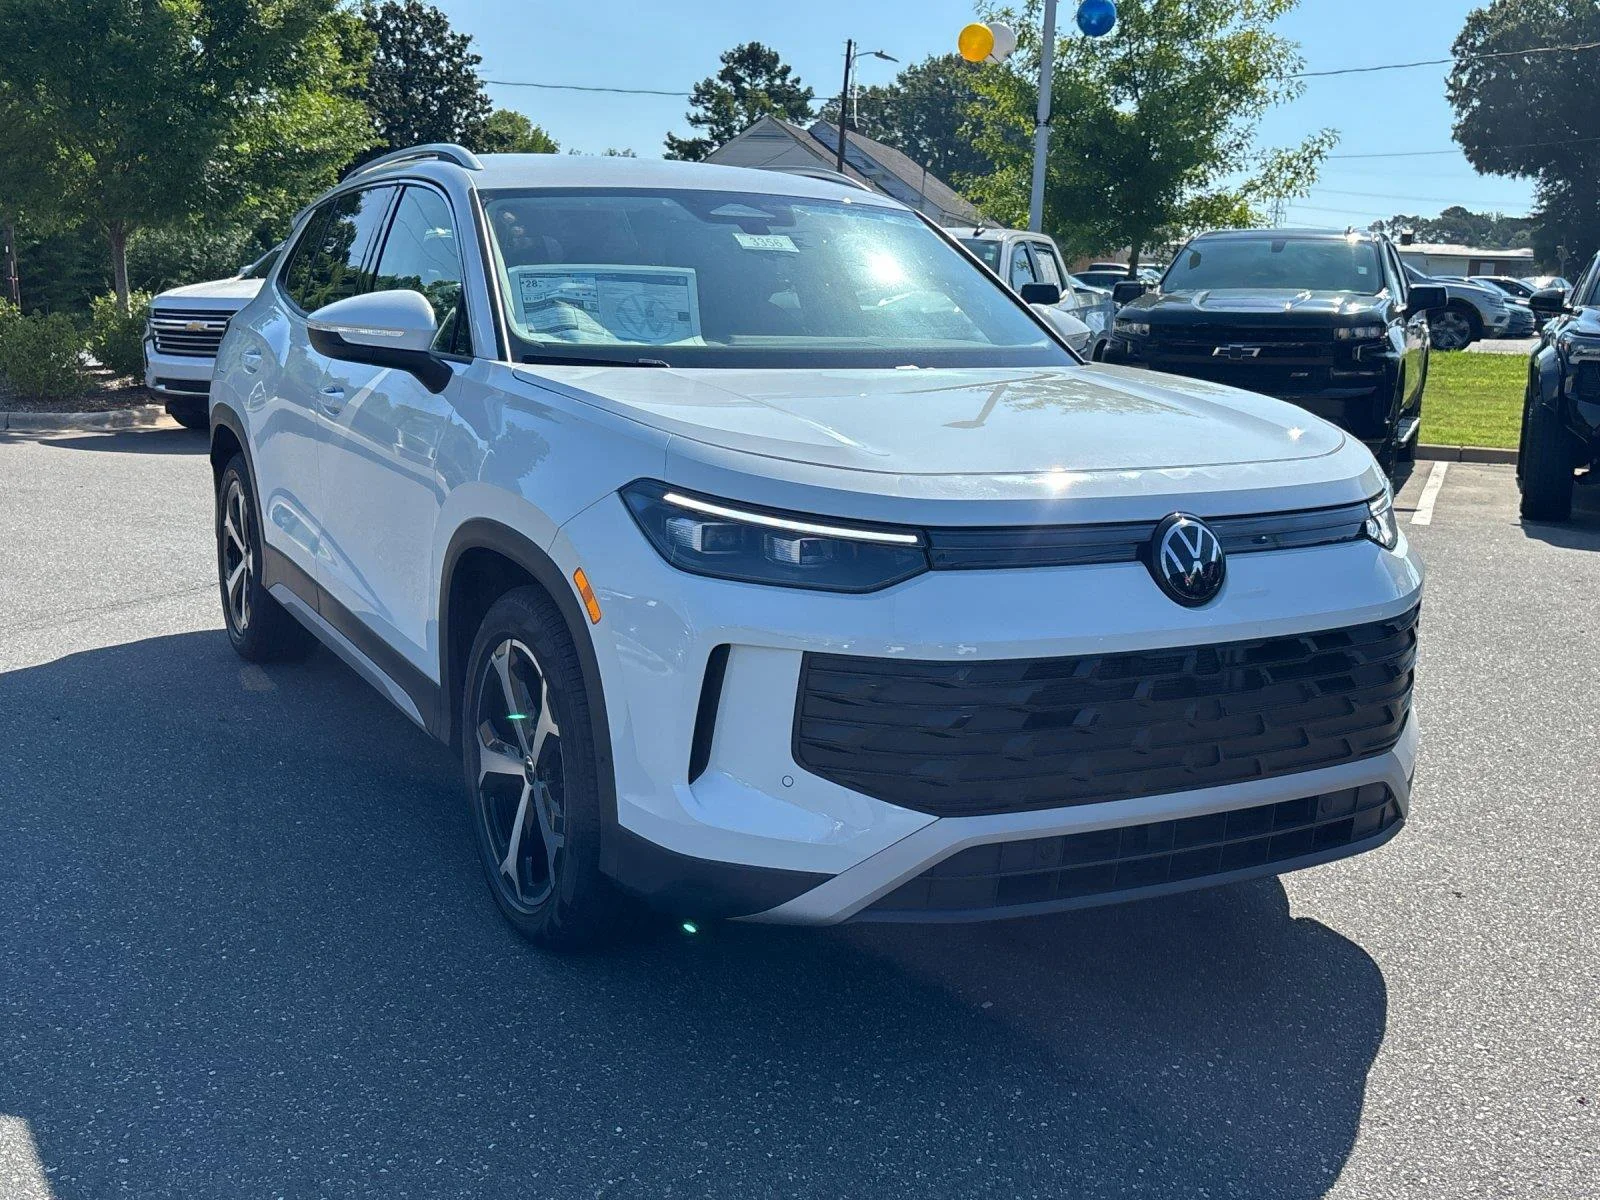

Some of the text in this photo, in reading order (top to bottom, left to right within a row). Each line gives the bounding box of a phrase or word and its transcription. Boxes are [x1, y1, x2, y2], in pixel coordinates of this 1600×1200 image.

[750, 237, 782, 247] 3356
[525, 280, 538, 288] 28
[1161, 520, 1223, 591] VW
